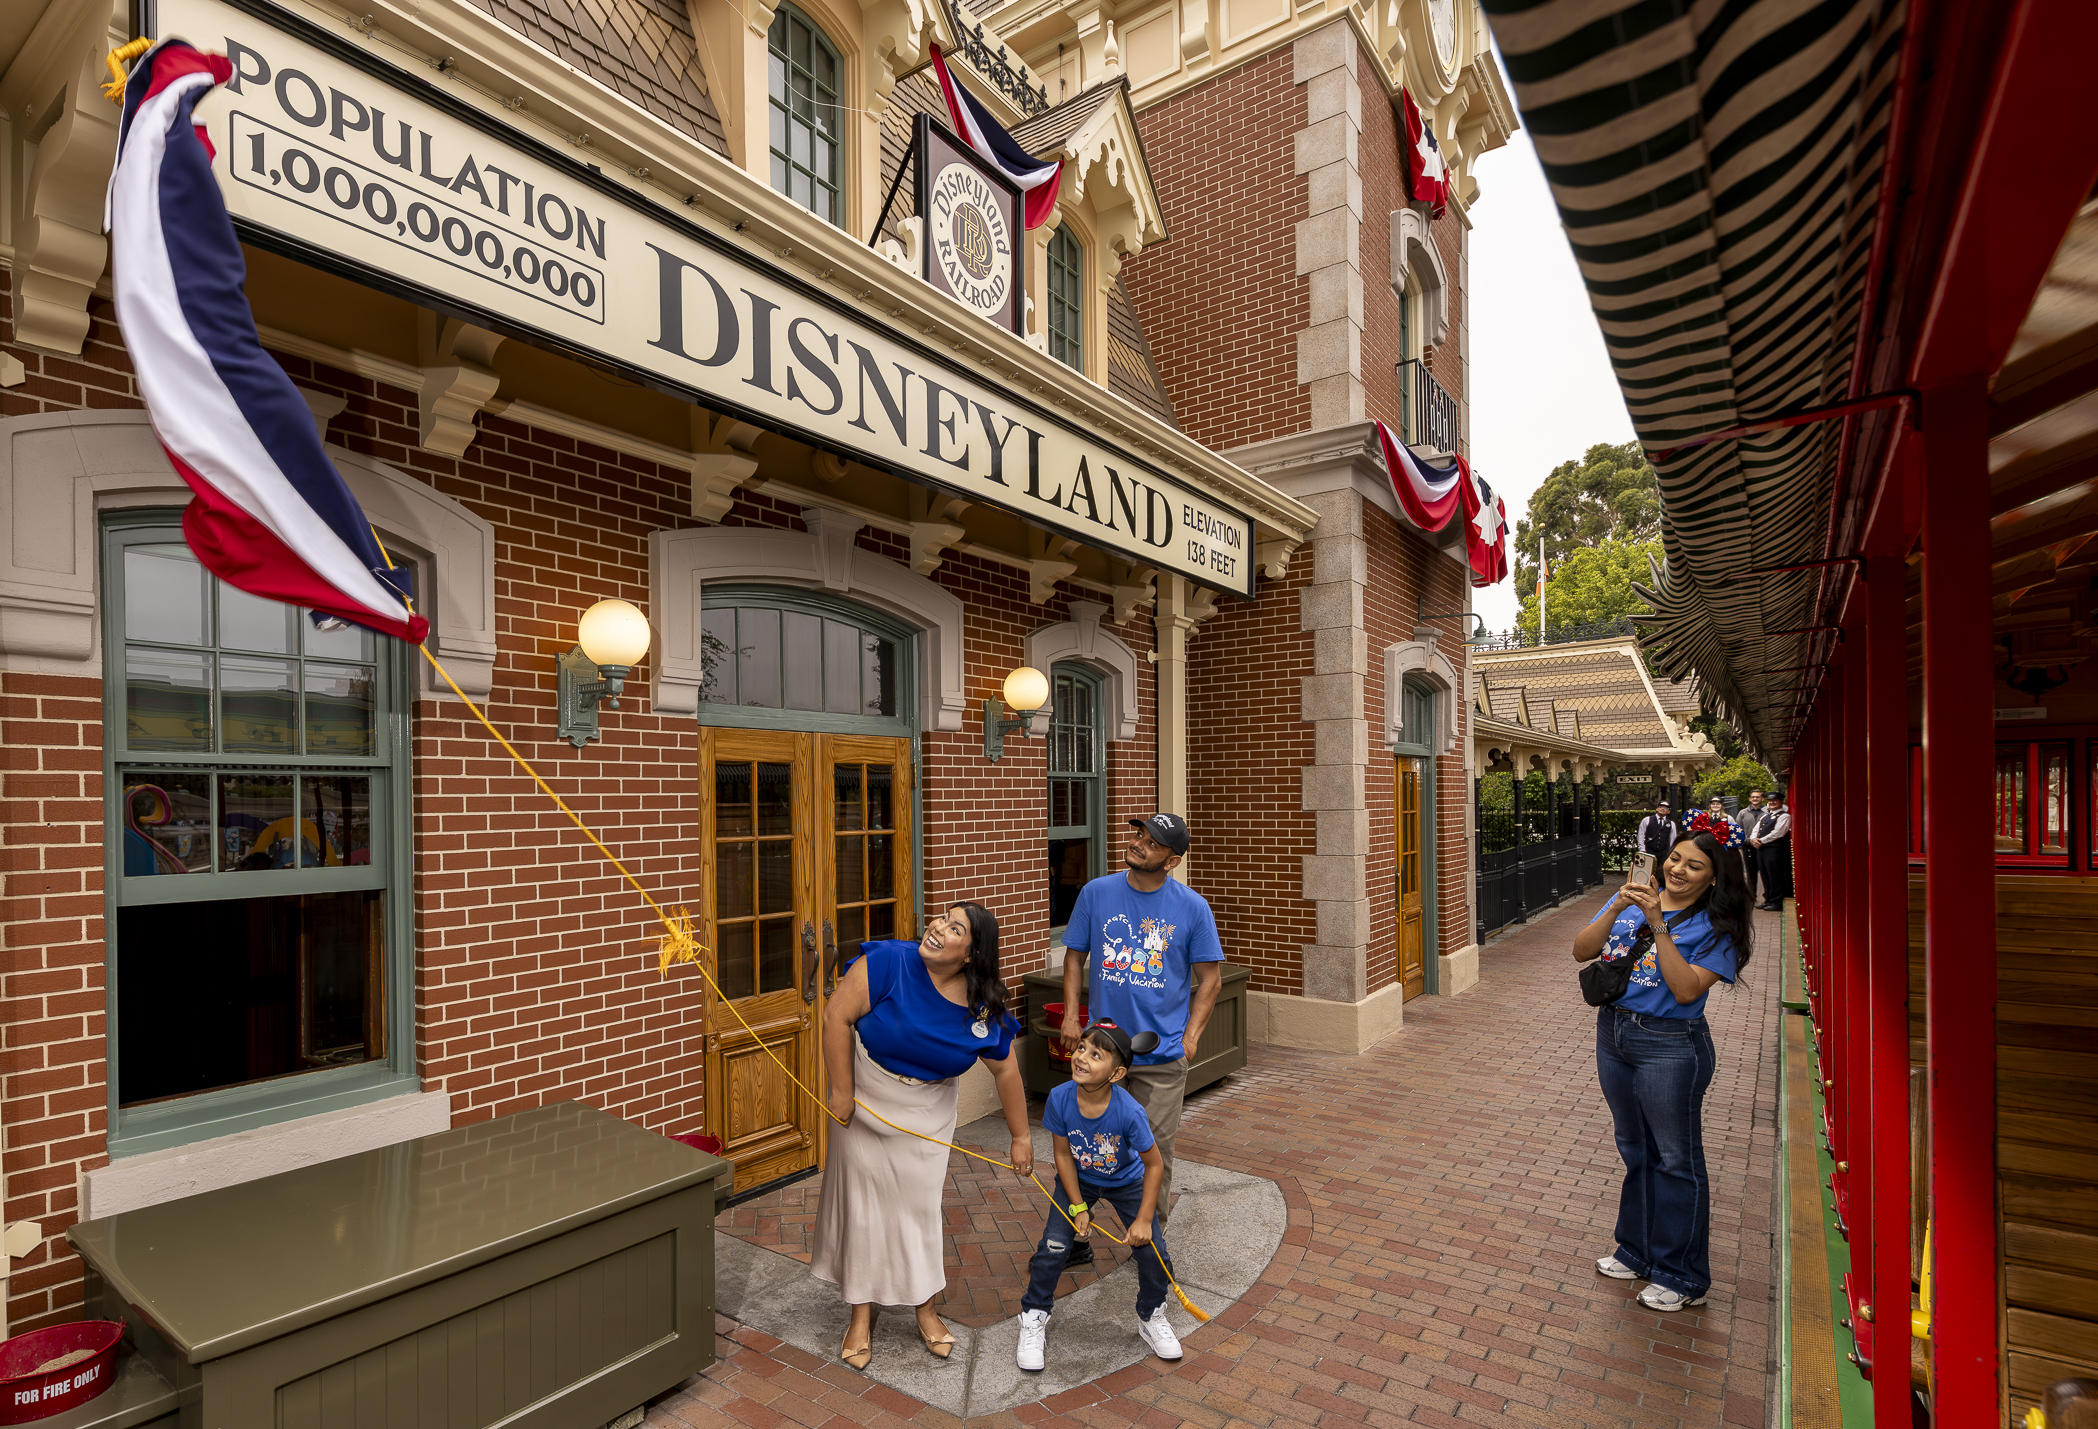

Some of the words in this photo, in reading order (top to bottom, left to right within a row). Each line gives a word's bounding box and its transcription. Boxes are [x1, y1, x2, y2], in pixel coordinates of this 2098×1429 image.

[224, 36, 607, 262] POPULATION
[246, 131, 596, 308] 1,000,000,000
[932, 170, 1010, 256] Disneyland
[938, 238, 1005, 309] RAILROAD
[645, 241, 1174, 549] DISNEYLAND
[1183, 503, 1241, 550] ELEVATION
[1187, 539, 1206, 566] 138
[1210, 548, 1236, 578] FEET
[1102, 943, 1164, 976] 2026
[15, 1388, 40, 1406] FOR
[43, 1378, 71, 1400] FIRE
[73, 1363, 101, 1389] ONLY
